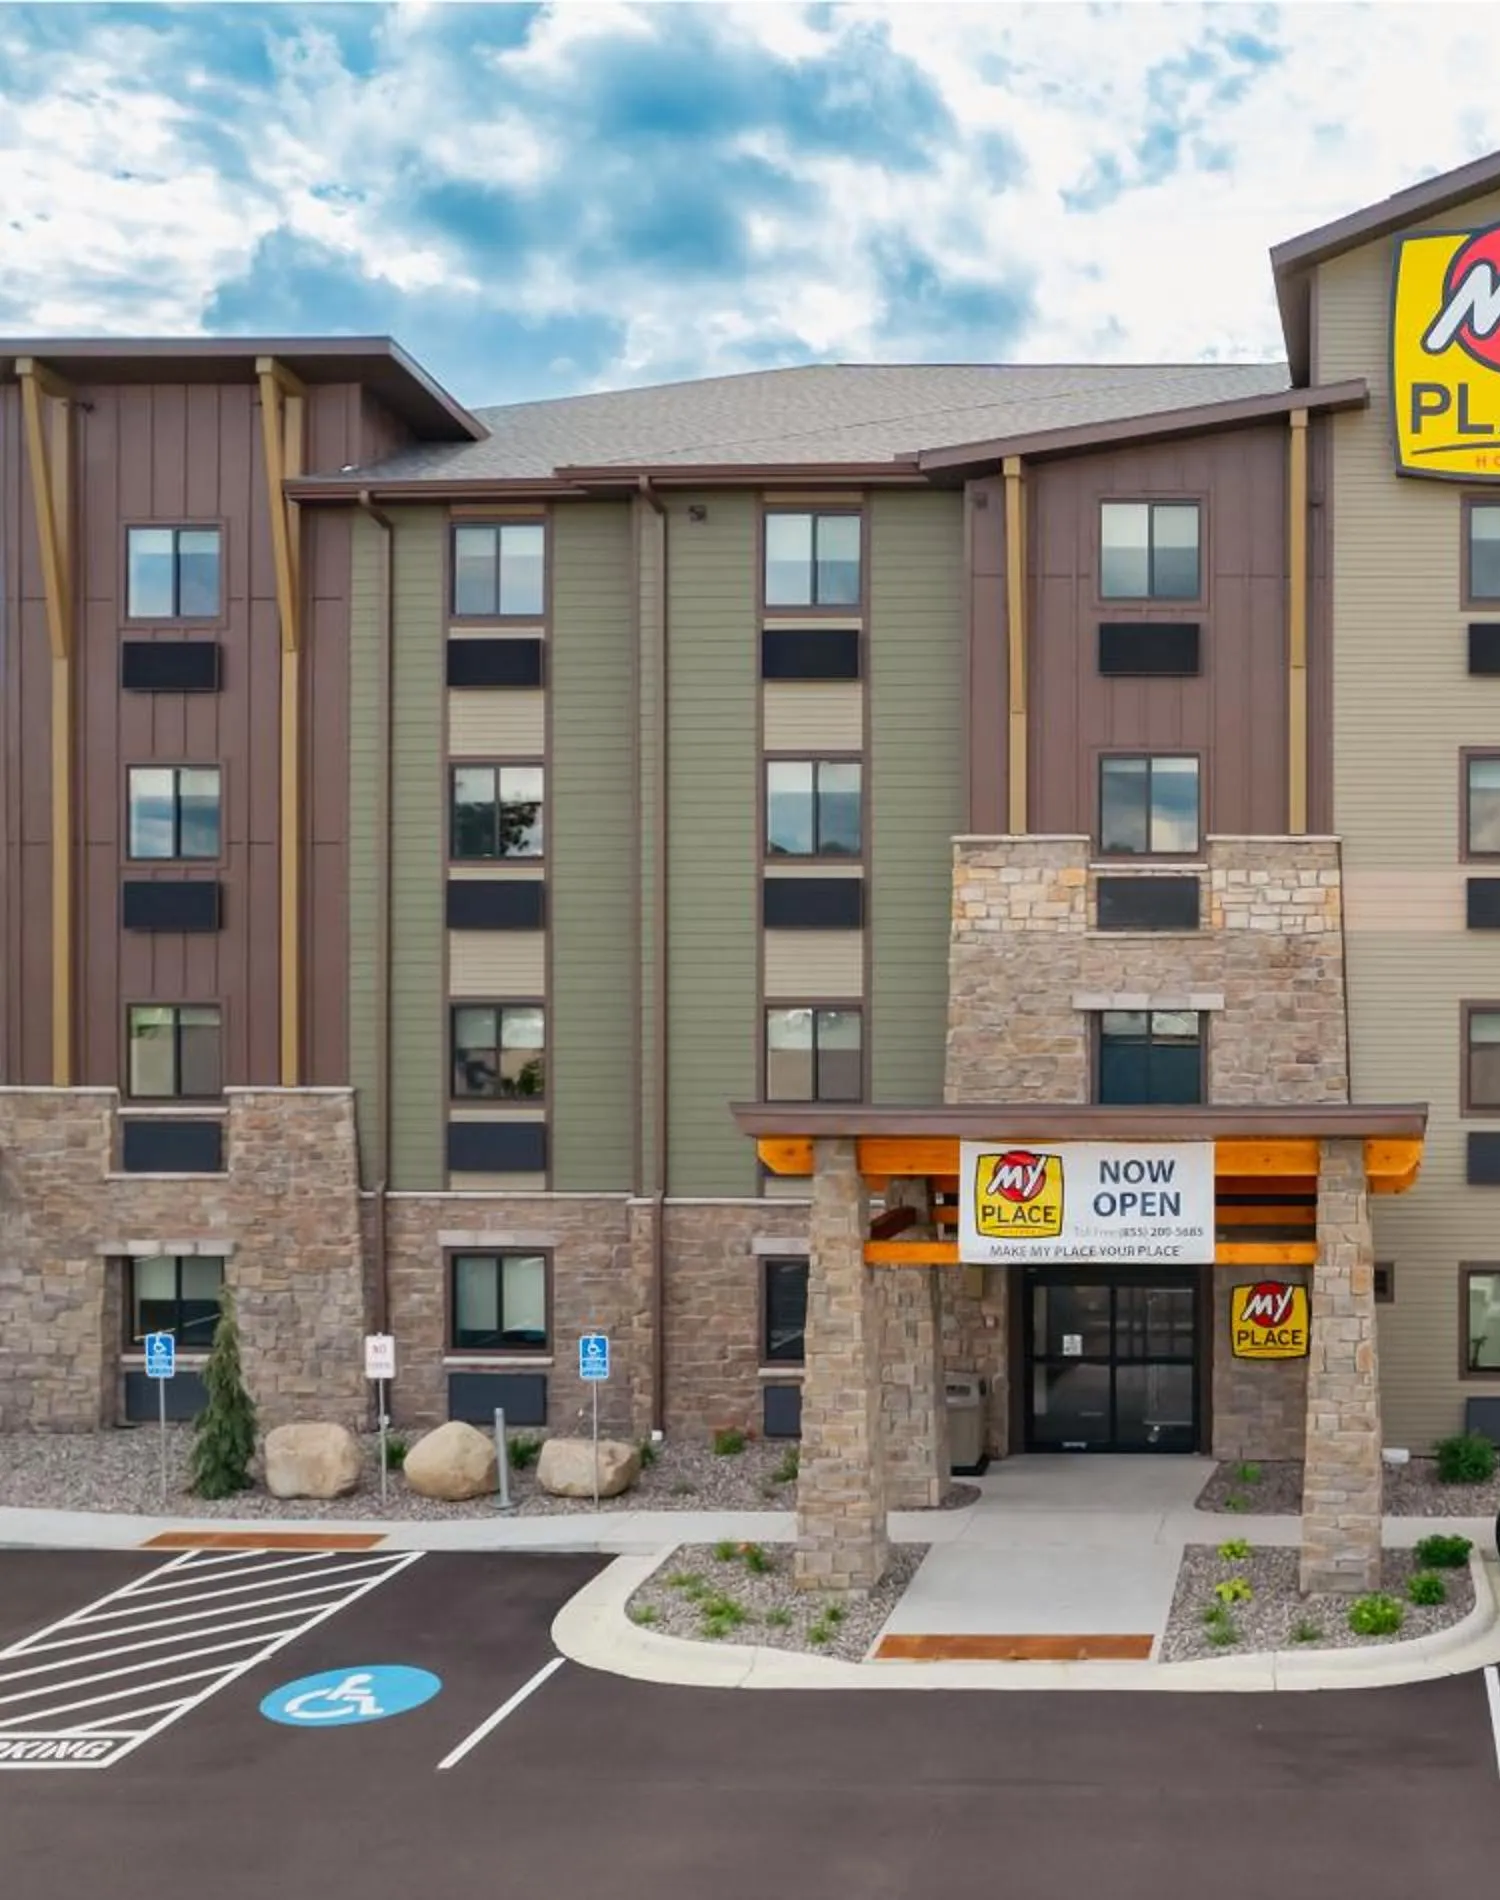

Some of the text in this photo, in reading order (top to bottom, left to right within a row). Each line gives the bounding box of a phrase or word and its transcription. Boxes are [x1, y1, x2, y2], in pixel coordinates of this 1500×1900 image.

[1099, 1159, 1176, 1185] NOW
[1092, 1191, 1182, 1218] OPEN
[981, 1205, 1057, 1224] PLACE
[989, 1245, 1181, 1258] MAKE MY PLACE YOUR PLACE
[1236, 1328, 1303, 1346] PLACE
[0, 1740, 113, 1759] KING
